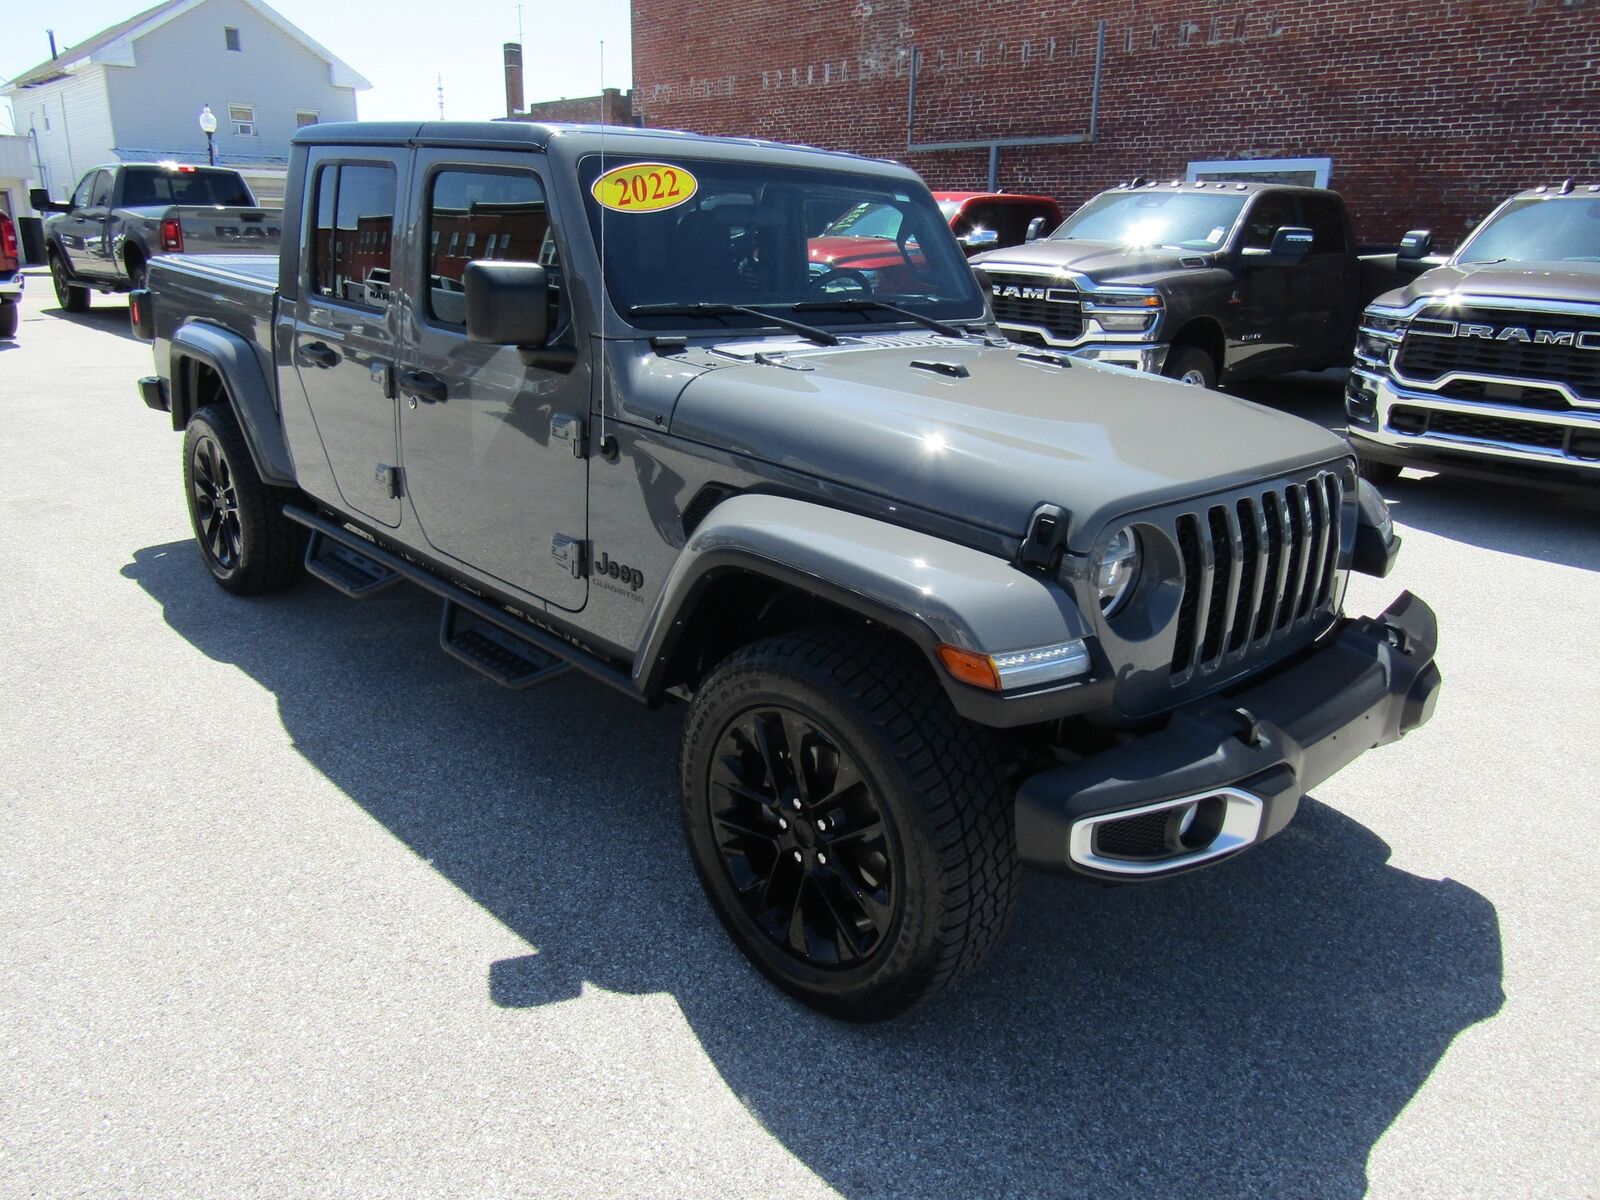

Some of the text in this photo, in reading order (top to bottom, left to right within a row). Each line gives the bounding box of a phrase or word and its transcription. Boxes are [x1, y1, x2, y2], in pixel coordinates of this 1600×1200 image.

[614, 170, 680, 206] 2022
[1458, 323, 1575, 346] RAM
[594, 551, 644, 592] Jeep
[592, 577, 645, 603] GLADIATOR
